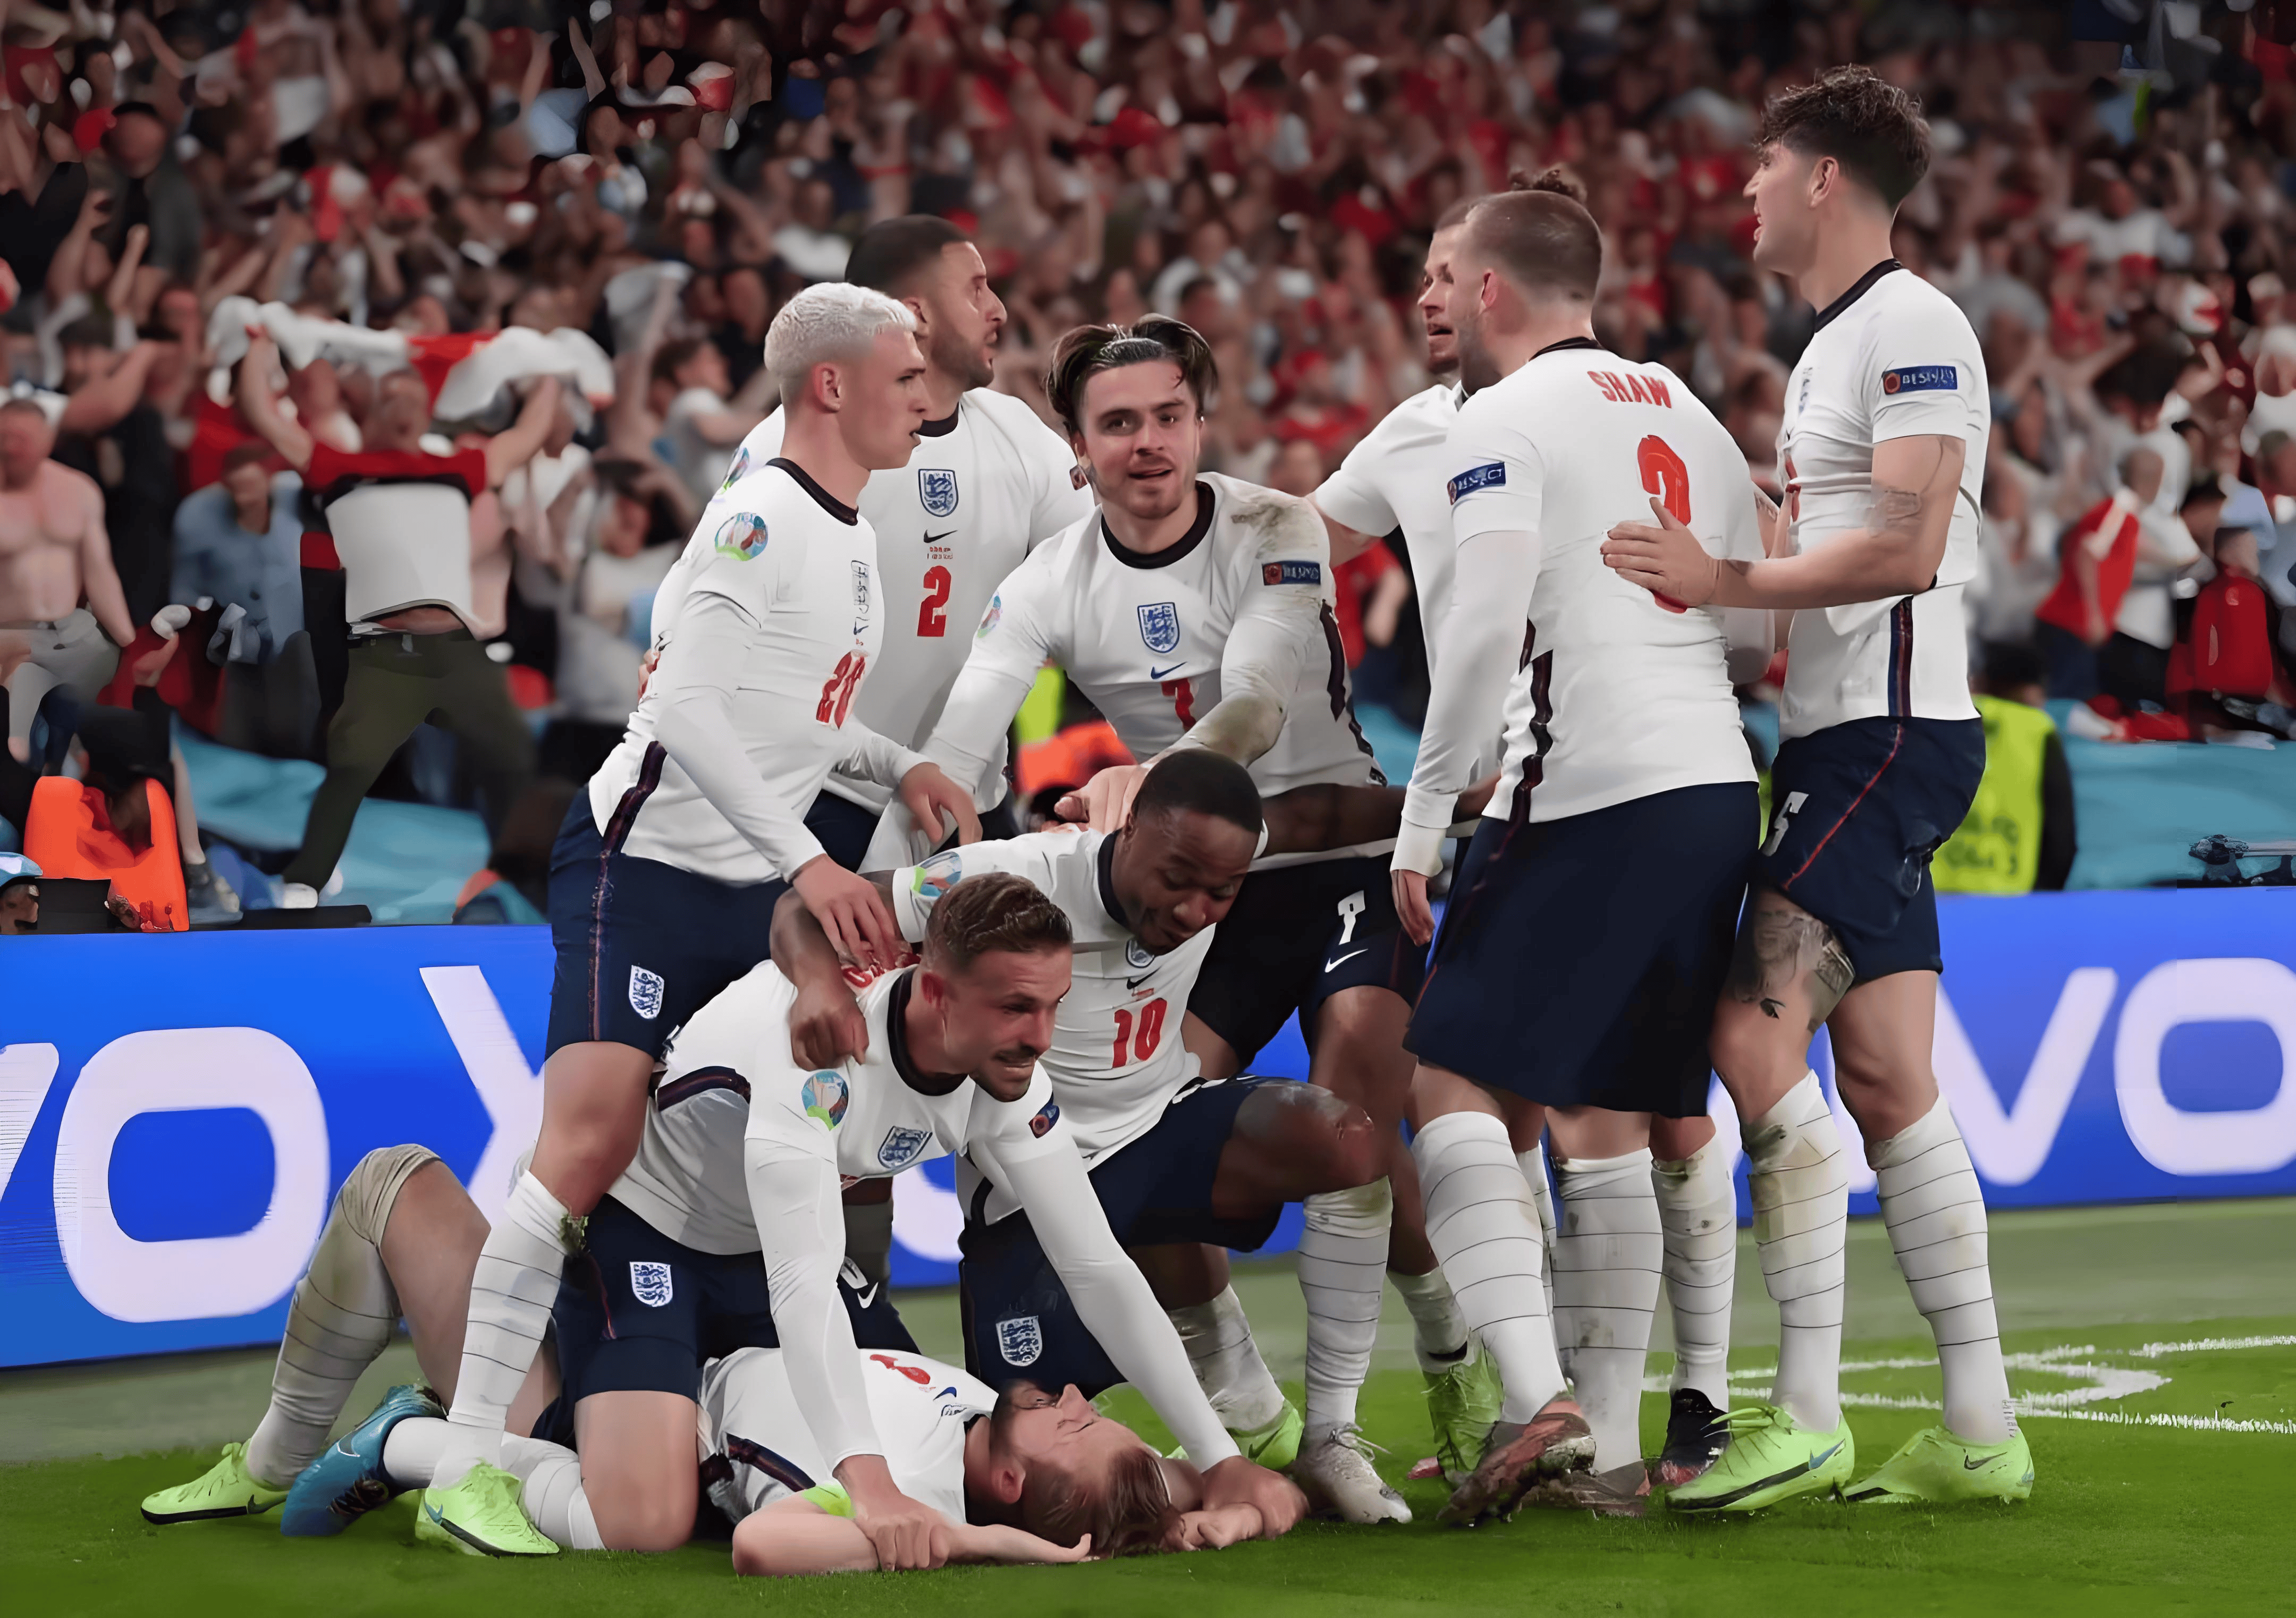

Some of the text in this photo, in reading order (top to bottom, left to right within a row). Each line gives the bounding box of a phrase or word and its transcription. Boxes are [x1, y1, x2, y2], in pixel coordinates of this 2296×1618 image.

[1587, 370, 1672, 408] SHAW
[917, 565, 952, 637] 2
[1112, 997, 1168, 1068] 10
